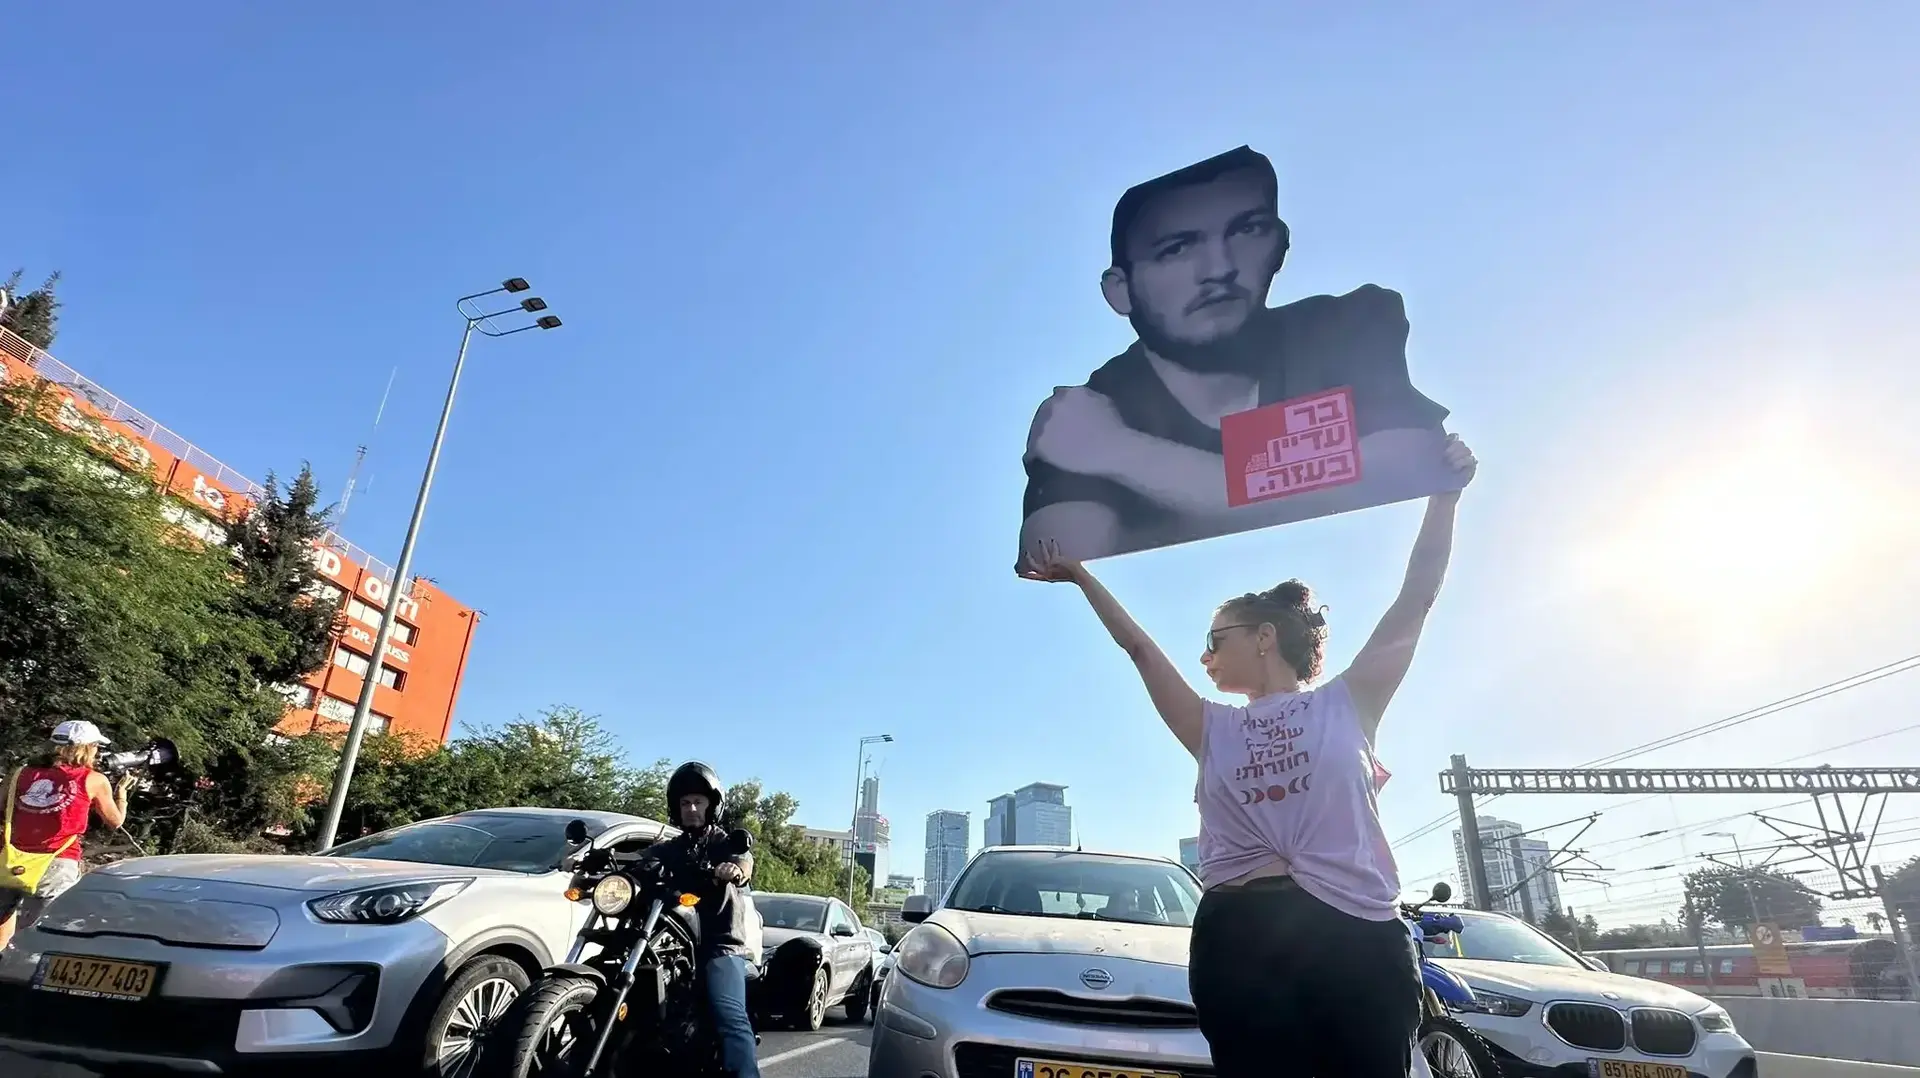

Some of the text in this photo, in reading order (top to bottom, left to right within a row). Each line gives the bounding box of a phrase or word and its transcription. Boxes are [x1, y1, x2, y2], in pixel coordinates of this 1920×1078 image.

[1293, 399, 1344, 426] בר
[1272, 424, 1346, 463] עדיין
[1259, 454, 1353, 493] בעזה.
